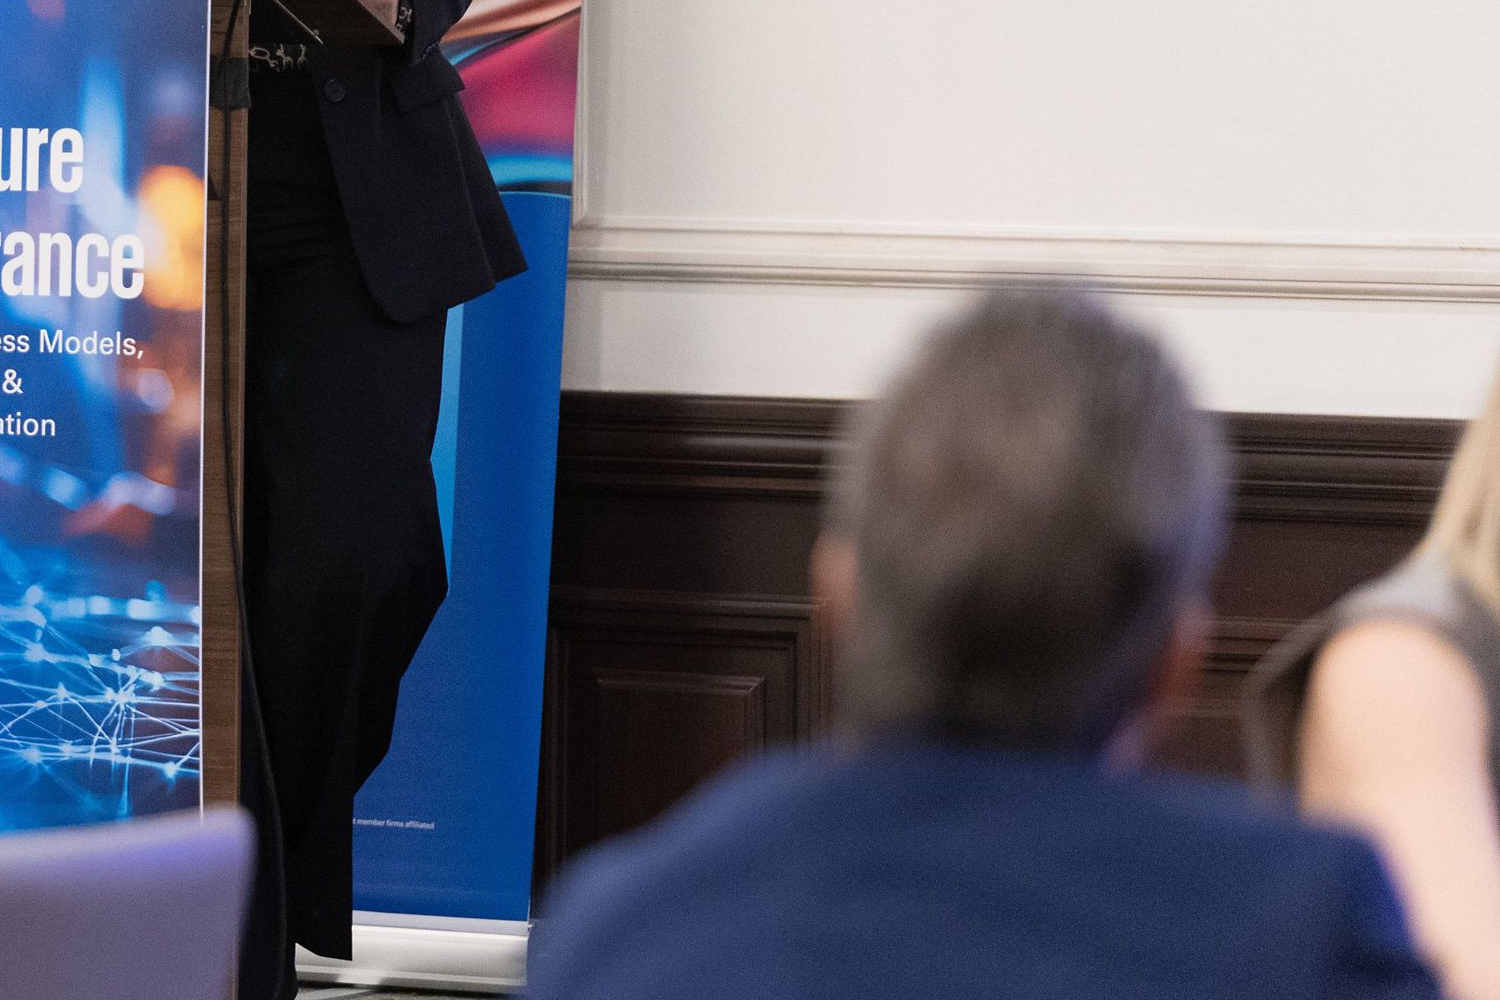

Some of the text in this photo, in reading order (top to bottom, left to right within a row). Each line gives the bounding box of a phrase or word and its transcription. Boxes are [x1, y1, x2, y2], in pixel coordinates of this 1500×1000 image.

[39, 329, 144, 359] Models,
[2, 369, 23, 394] &
[405, 820, 435, 830] affiliated
